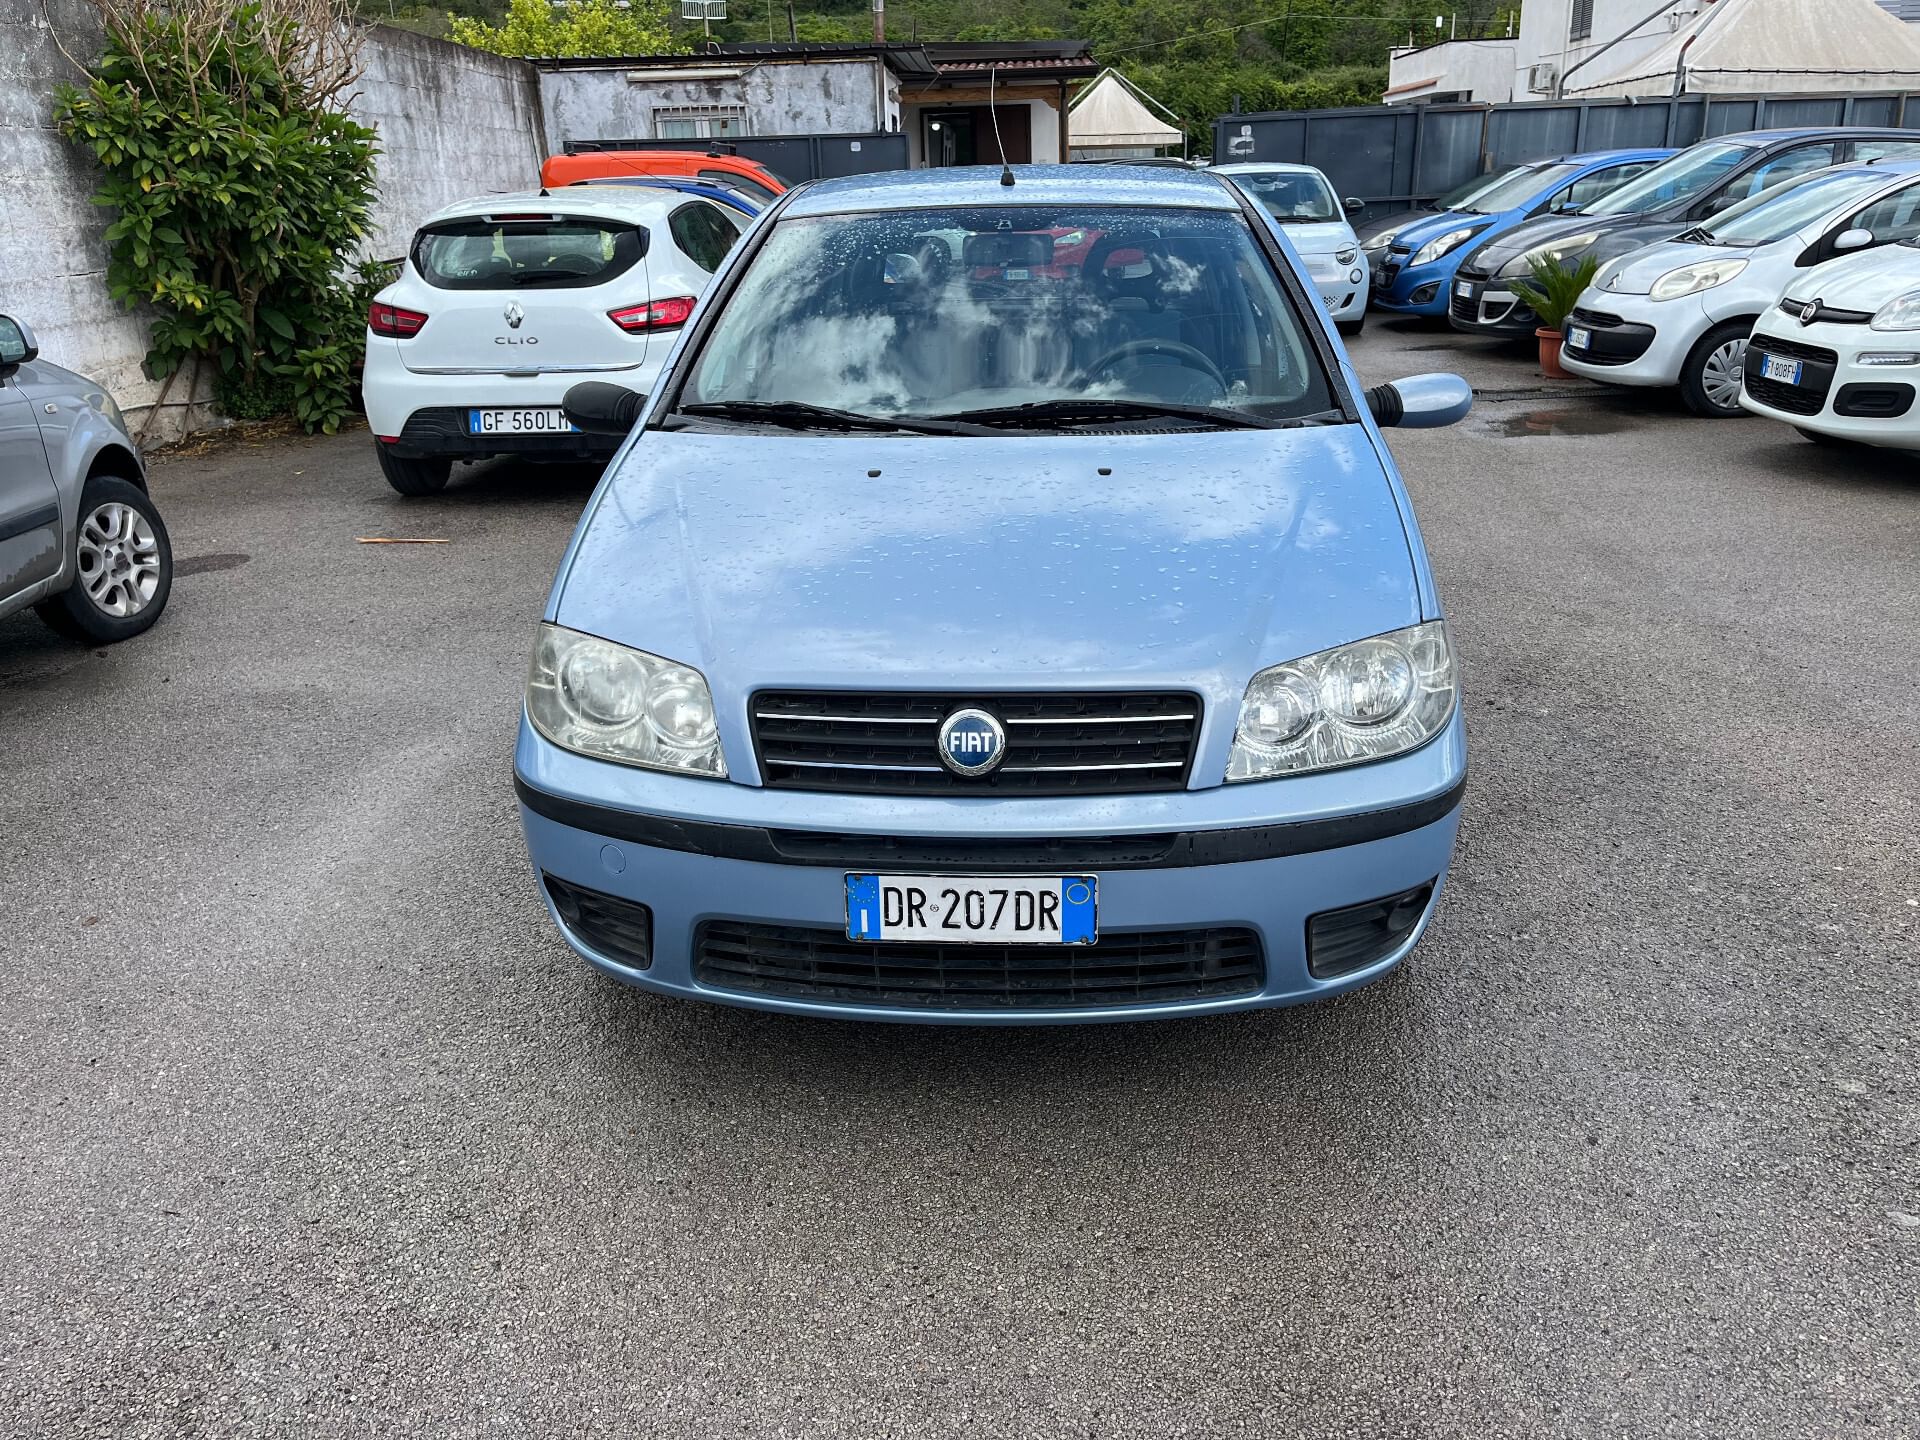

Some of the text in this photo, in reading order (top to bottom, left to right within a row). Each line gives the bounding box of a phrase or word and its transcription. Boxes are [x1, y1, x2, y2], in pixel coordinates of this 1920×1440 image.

[494, 336, 538, 345] CLIO
[483, 412, 504, 431] GF
[950, 731, 993, 753] FIAT
[860, 886, 1060, 933] I DR 207DR
